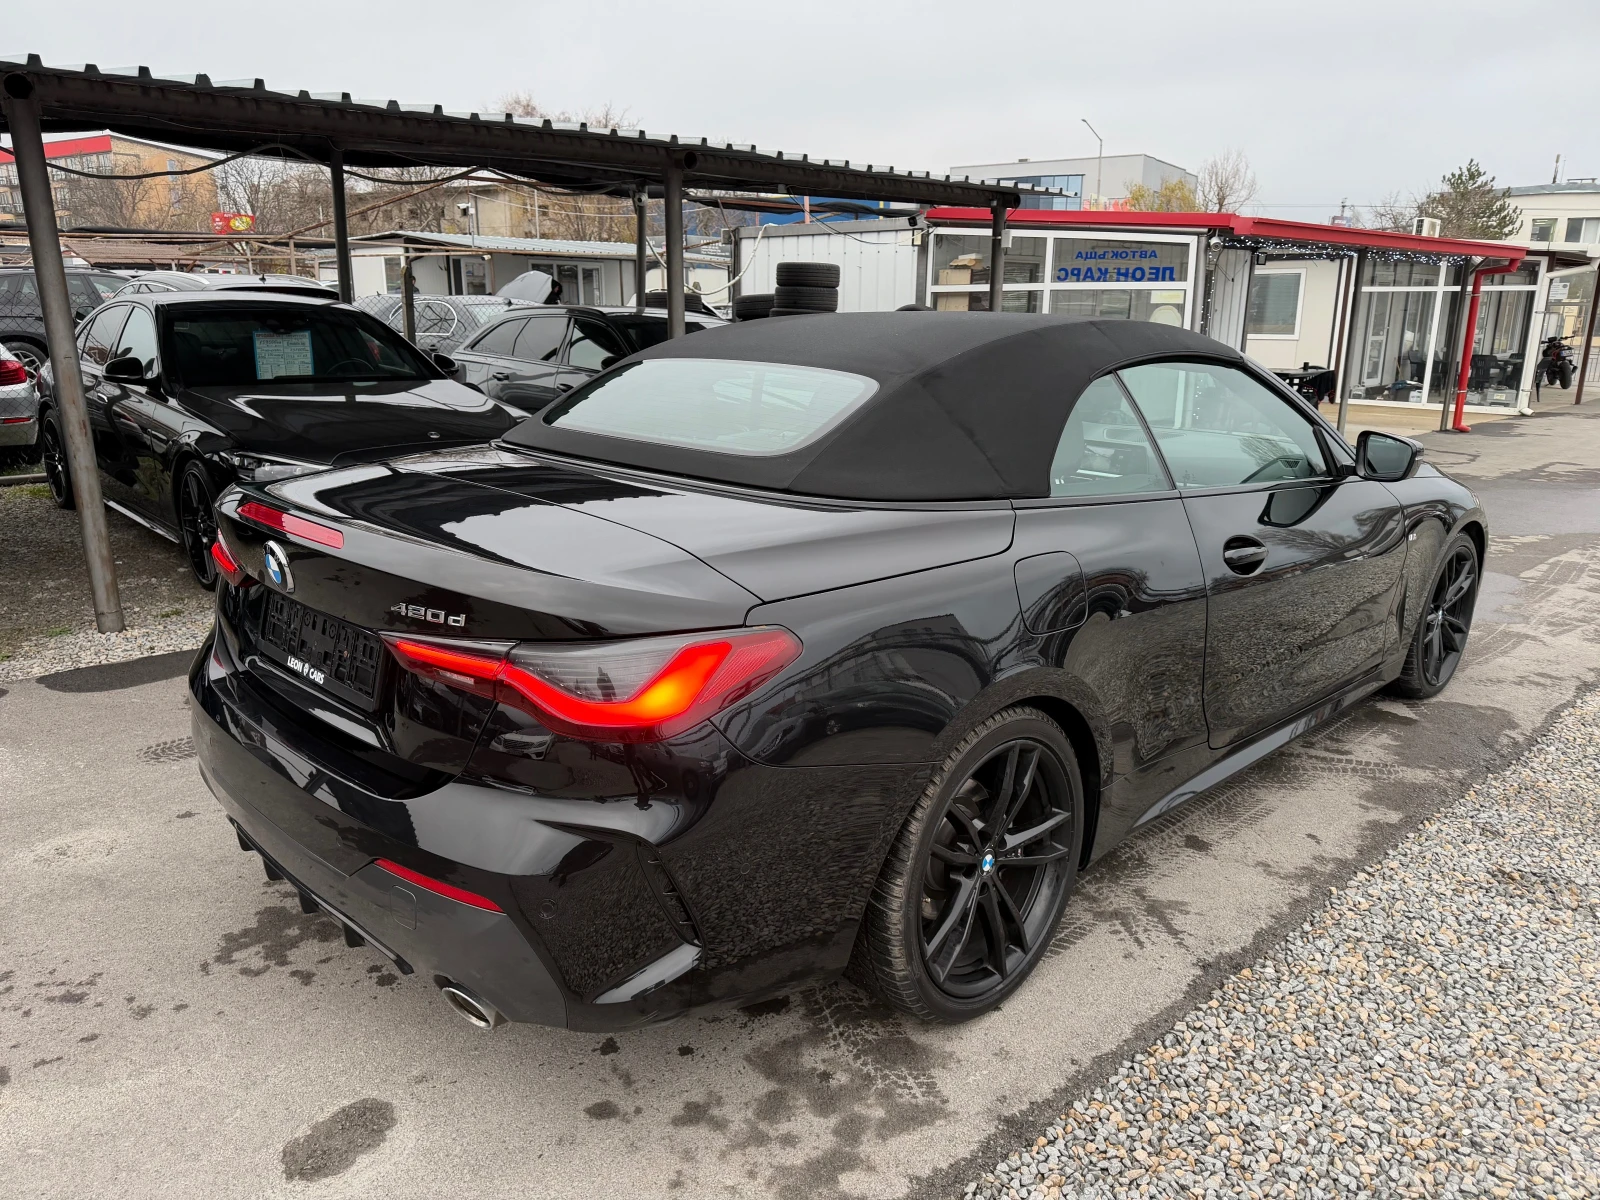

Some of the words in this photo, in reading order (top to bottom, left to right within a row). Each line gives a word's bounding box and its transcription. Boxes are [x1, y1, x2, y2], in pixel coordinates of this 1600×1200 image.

[390, 602, 466, 627] 420d
[287, 655, 304, 673] LEON
[309, 668, 325, 685] CARS
